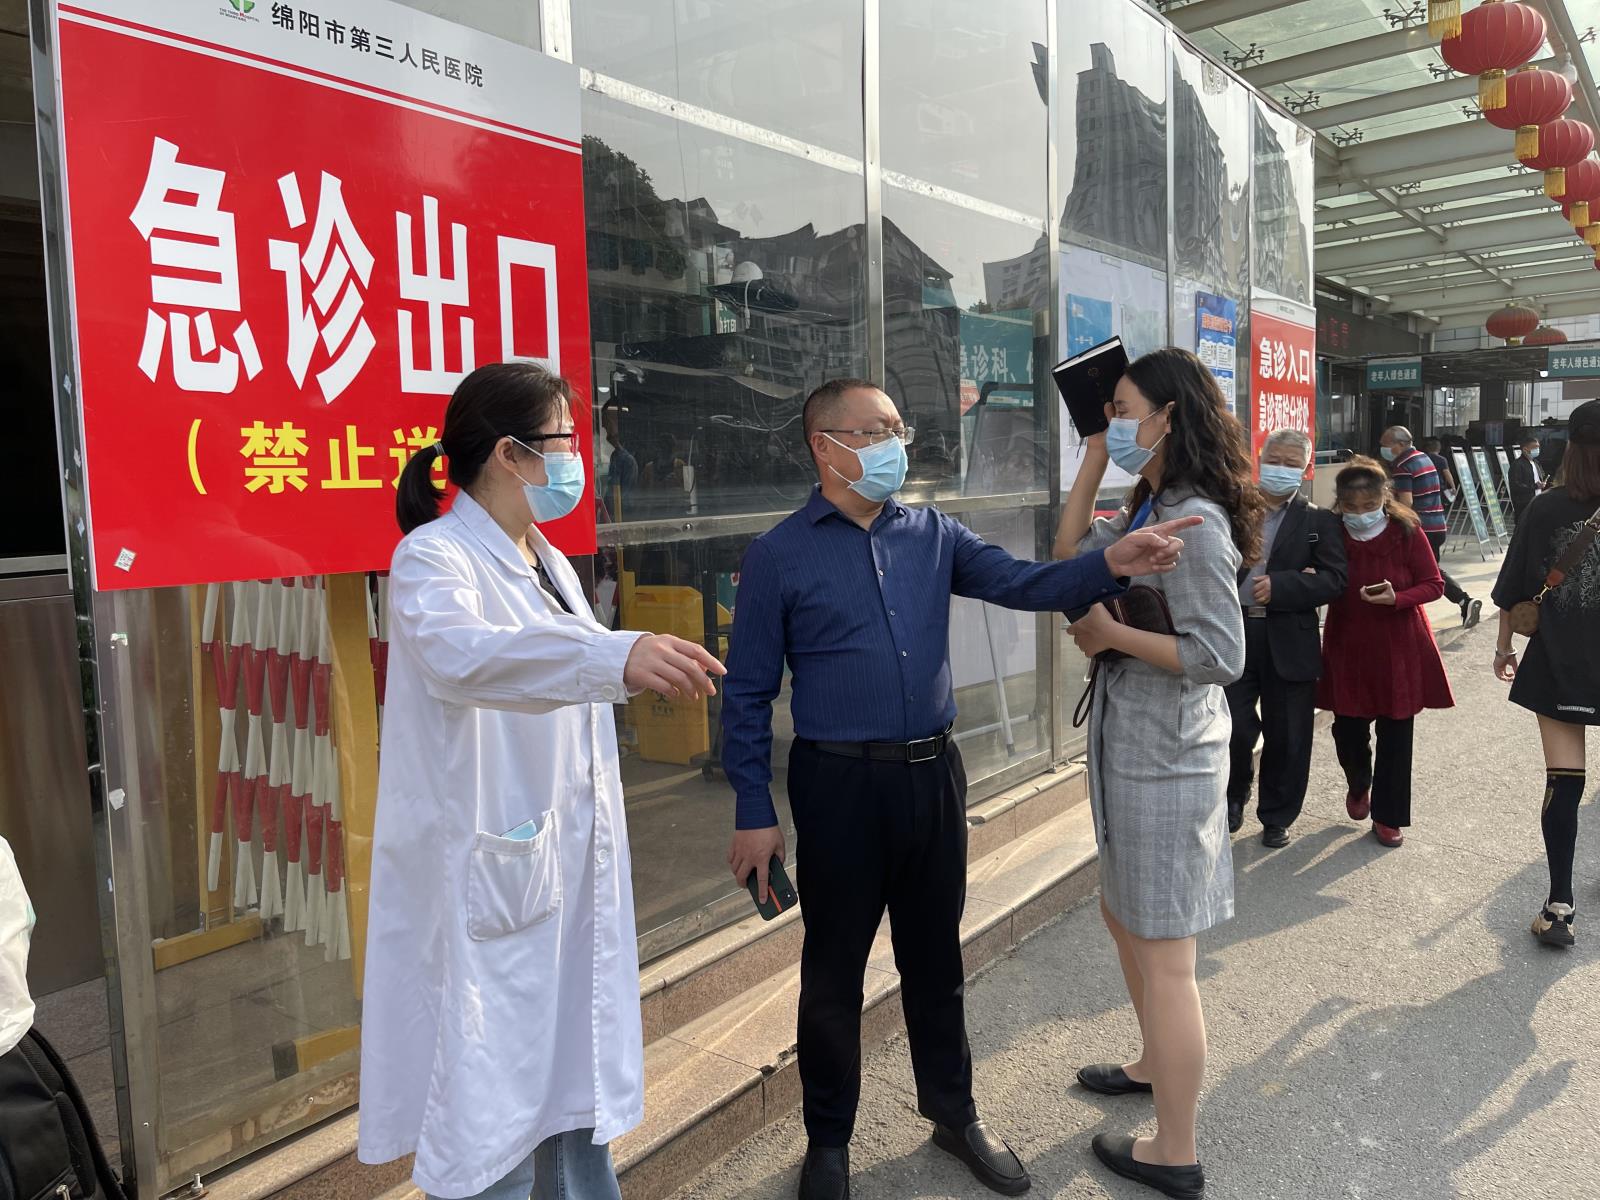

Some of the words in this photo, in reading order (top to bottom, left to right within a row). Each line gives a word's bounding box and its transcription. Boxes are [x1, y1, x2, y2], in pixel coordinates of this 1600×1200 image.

[271, 2, 483, 87] 绵阳市第三人民医院
[130, 136, 560, 404] 急诊出口
[1259, 336, 1310, 385] 急诊入口
[1259, 390, 1310, 434] 急诊预检分诊处
